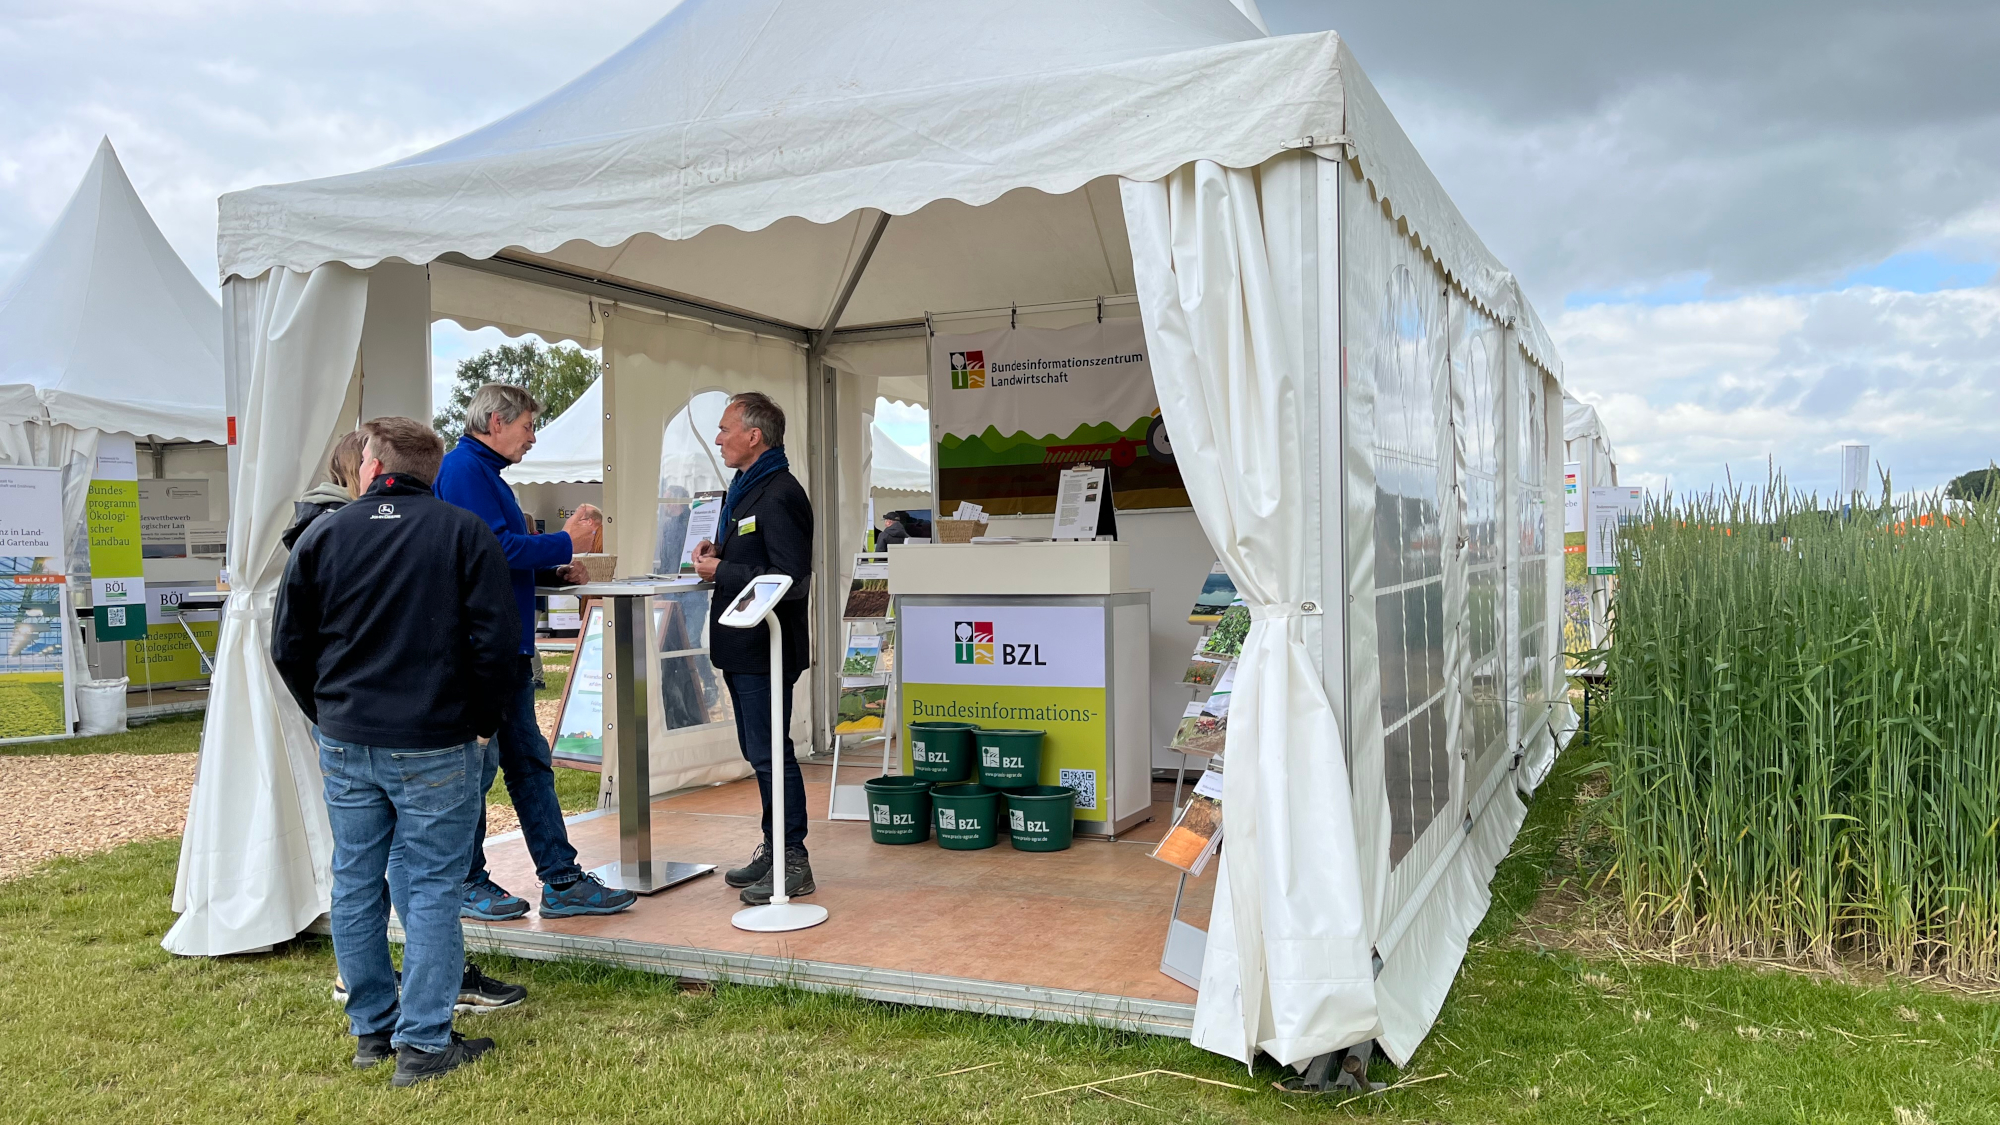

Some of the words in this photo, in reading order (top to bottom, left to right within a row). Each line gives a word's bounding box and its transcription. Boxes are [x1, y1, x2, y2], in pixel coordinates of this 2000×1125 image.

[991, 353, 1143, 373] Bundesinformationszentrum
[991, 372, 1069, 387] Landwirtschaft
[88, 485, 127, 495] Bundes-
[89, 500, 137, 510] programm
[89, 509, 130, 522] Ökologi-
[10, 528, 19, 536] in
[21, 528, 45, 536] Land-
[90, 524, 115, 533] scher
[7, 538, 49, 547] Gartenbau
[91, 537, 130, 546] Landbau
[105, 581, 127, 592] BÖL
[1002, 643, 1047, 666] BZL
[912, 700, 1098, 722] Bundesinformations-
[928, 752, 950, 763] BZL
[1002, 757, 1025, 768] BZL
[893, 814, 915, 825] BZL
[959, 819, 981, 830] BZL
[1026, 821, 1050, 832] BZL
